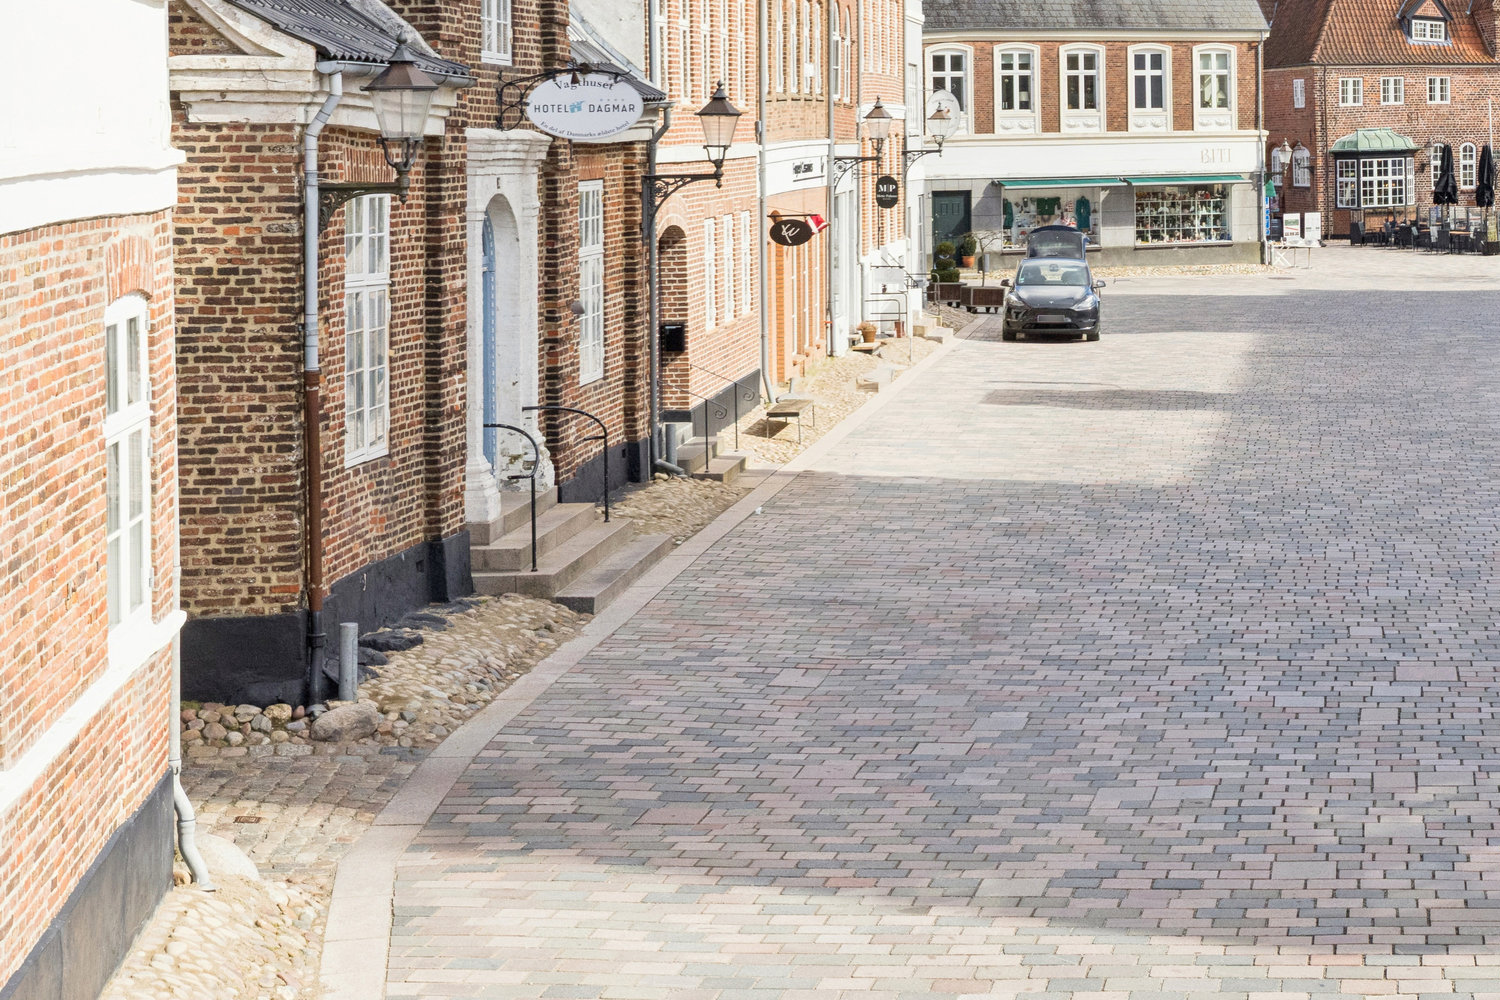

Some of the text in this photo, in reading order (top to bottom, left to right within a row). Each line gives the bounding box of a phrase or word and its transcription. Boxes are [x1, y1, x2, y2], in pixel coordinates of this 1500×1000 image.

[554, 78, 614, 90] Vagthuset
[534, 104, 635, 113] HOTEL DAGMAR
